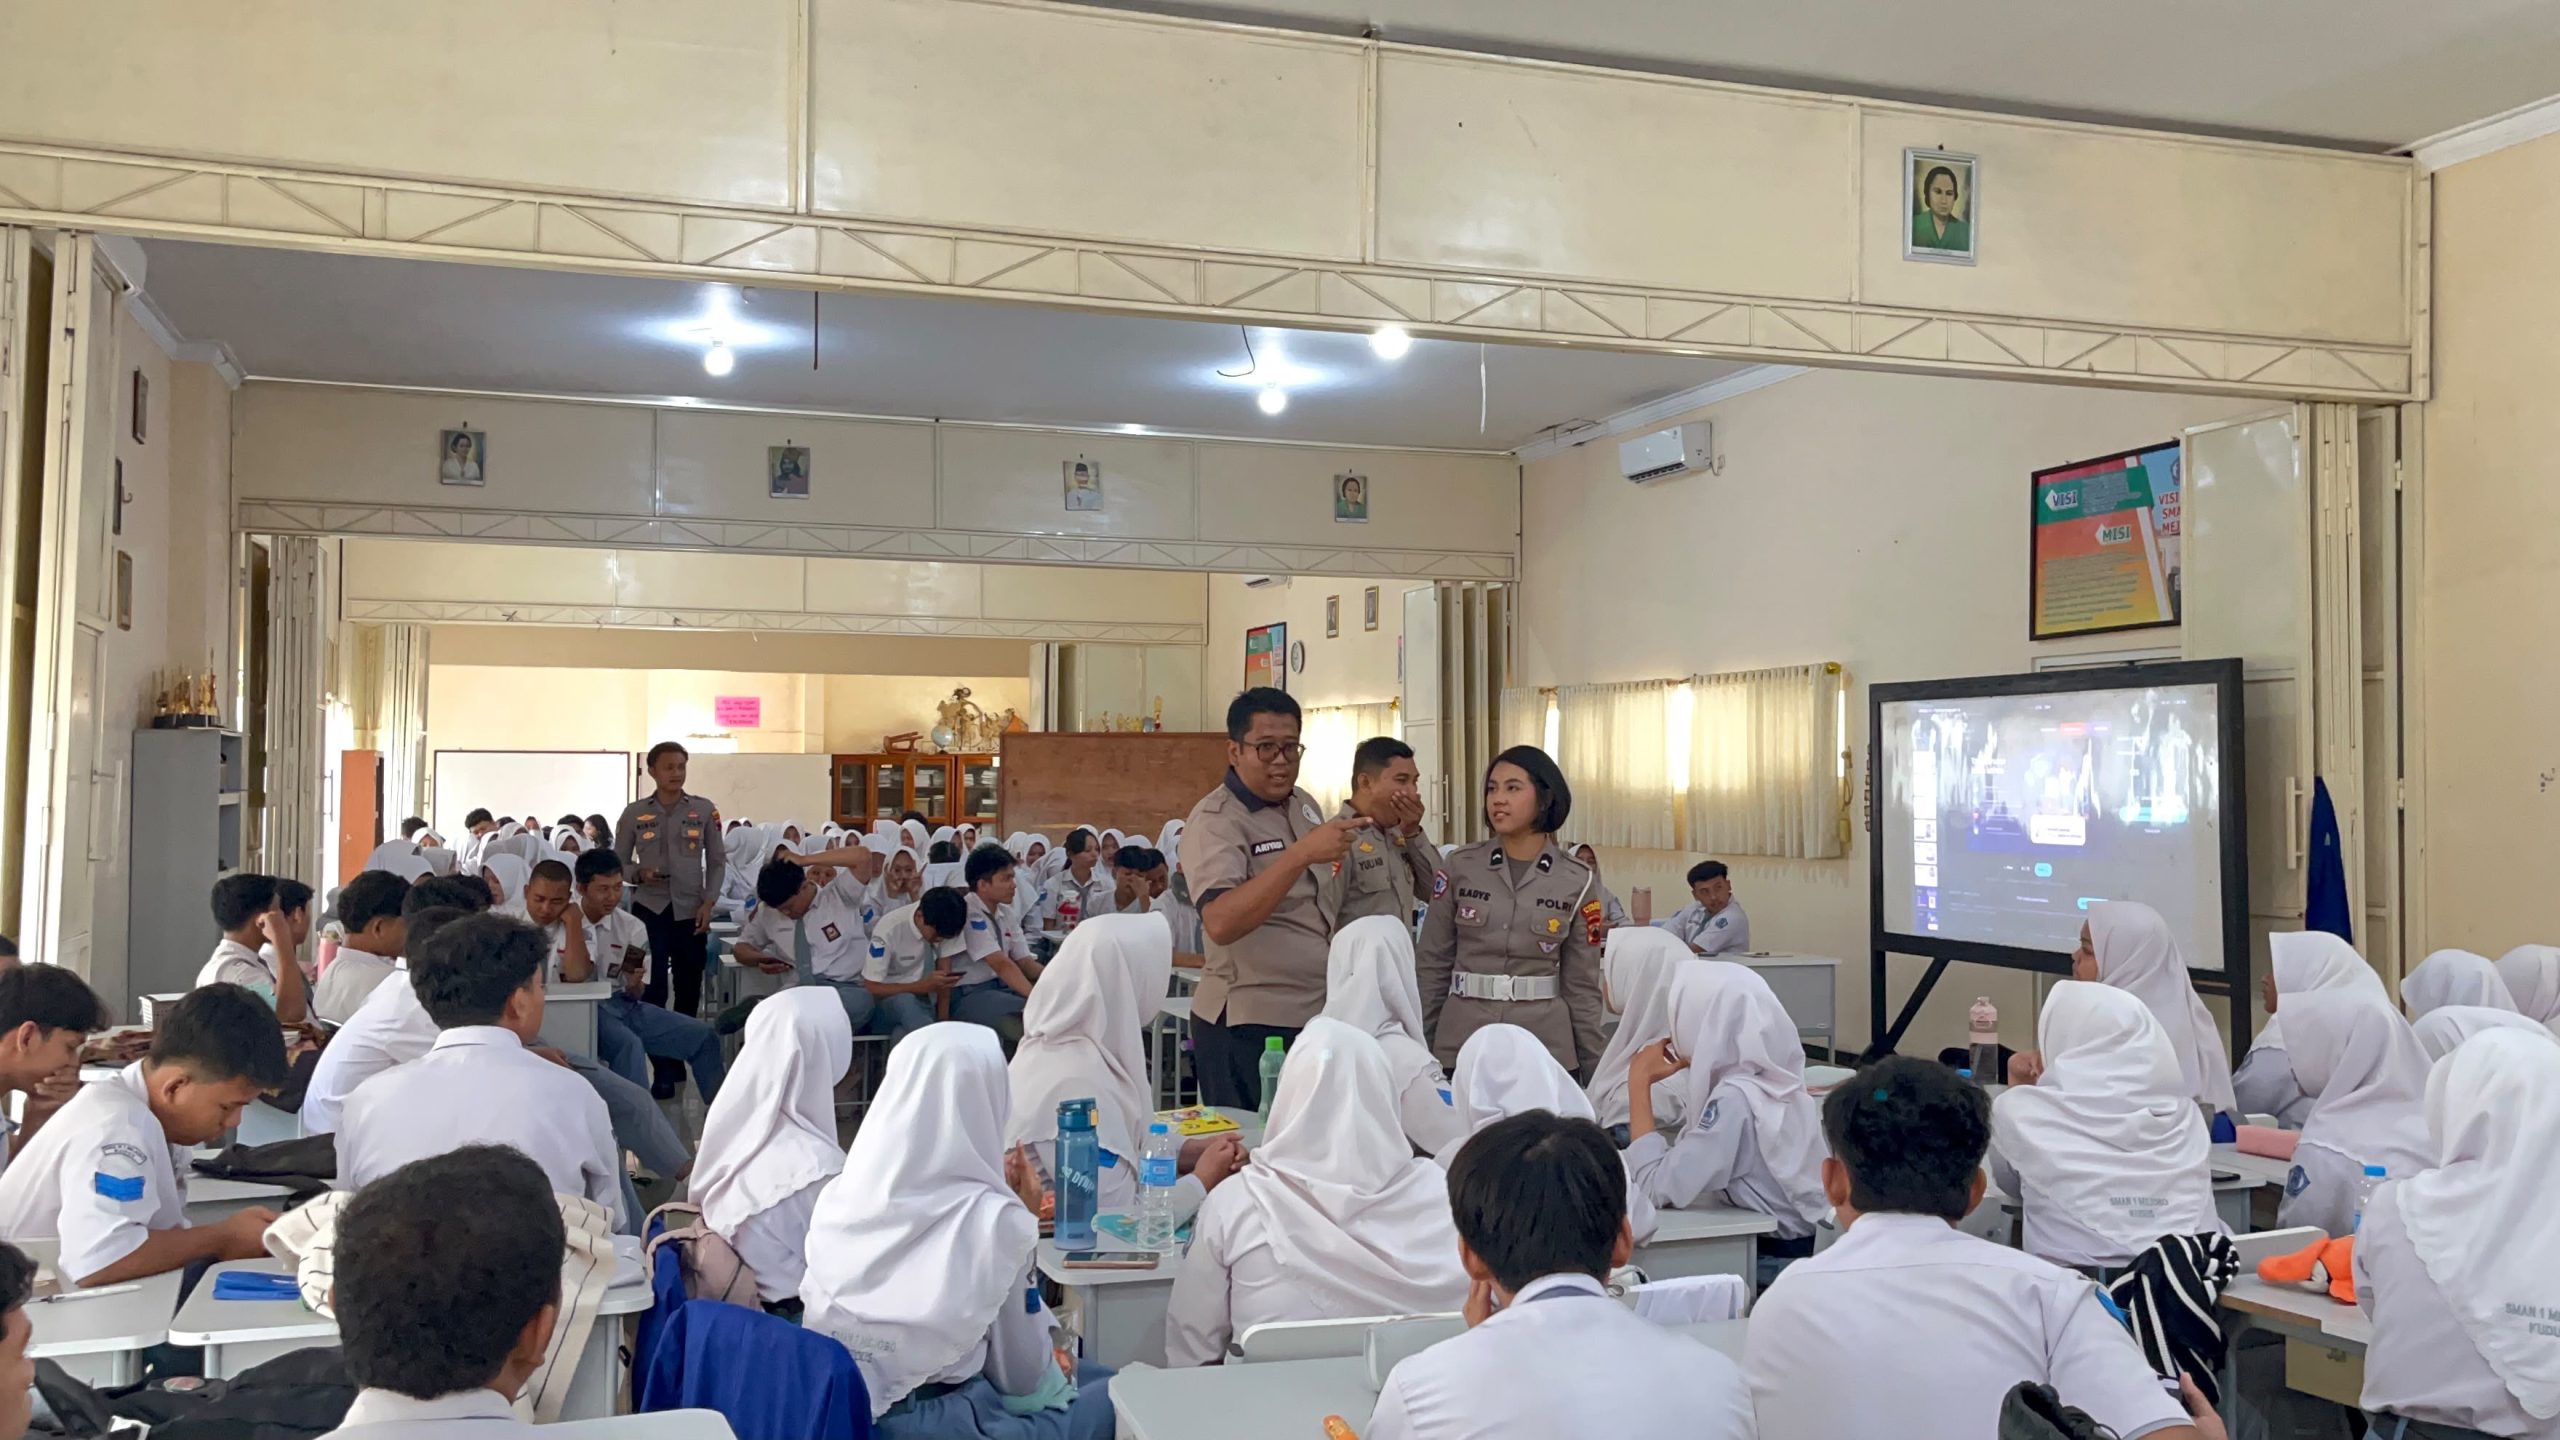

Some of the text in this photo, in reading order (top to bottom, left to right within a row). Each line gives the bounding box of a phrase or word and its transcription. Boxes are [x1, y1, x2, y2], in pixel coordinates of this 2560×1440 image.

[2053, 491, 2077, 507] VISI
[2159, 491, 2180, 505] VISI
[2102, 526, 2131, 542] MISI
[1536, 898, 1573, 913] POLRI
[2505, 1303, 2536, 1319] SMAN
